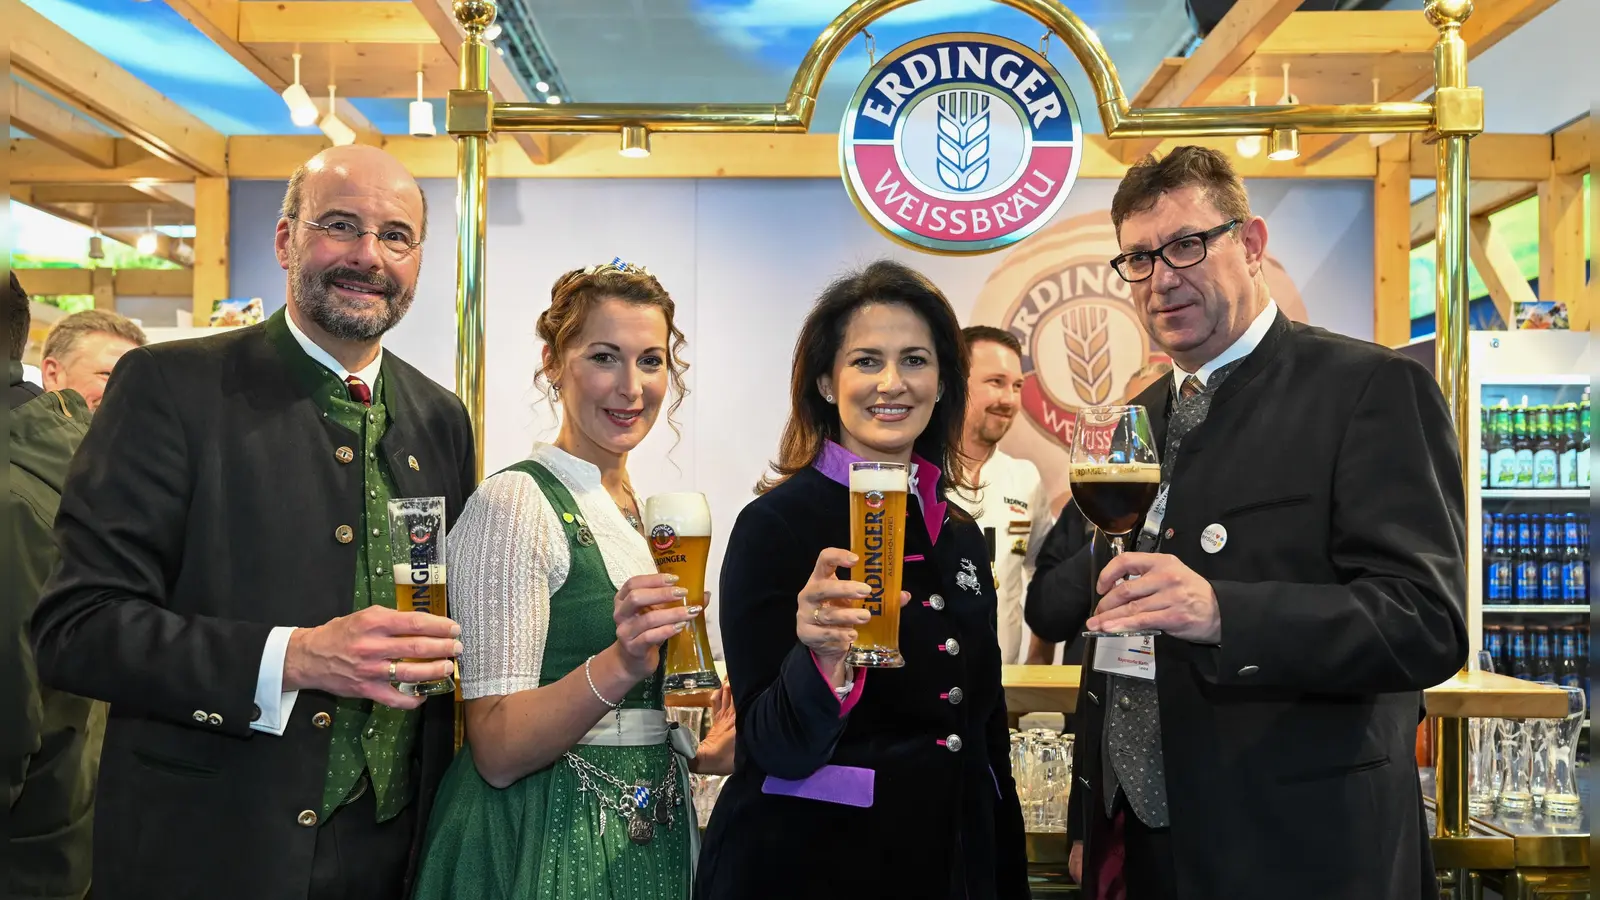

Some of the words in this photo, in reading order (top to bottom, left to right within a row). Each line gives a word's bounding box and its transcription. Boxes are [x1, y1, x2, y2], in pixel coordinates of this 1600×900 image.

[861, 46, 1062, 129] ERDINGER
[874, 168, 1056, 235] WEISSBRÄU
[1019, 264, 1134, 356] RDING
[864, 508, 885, 617] ERDINGER
